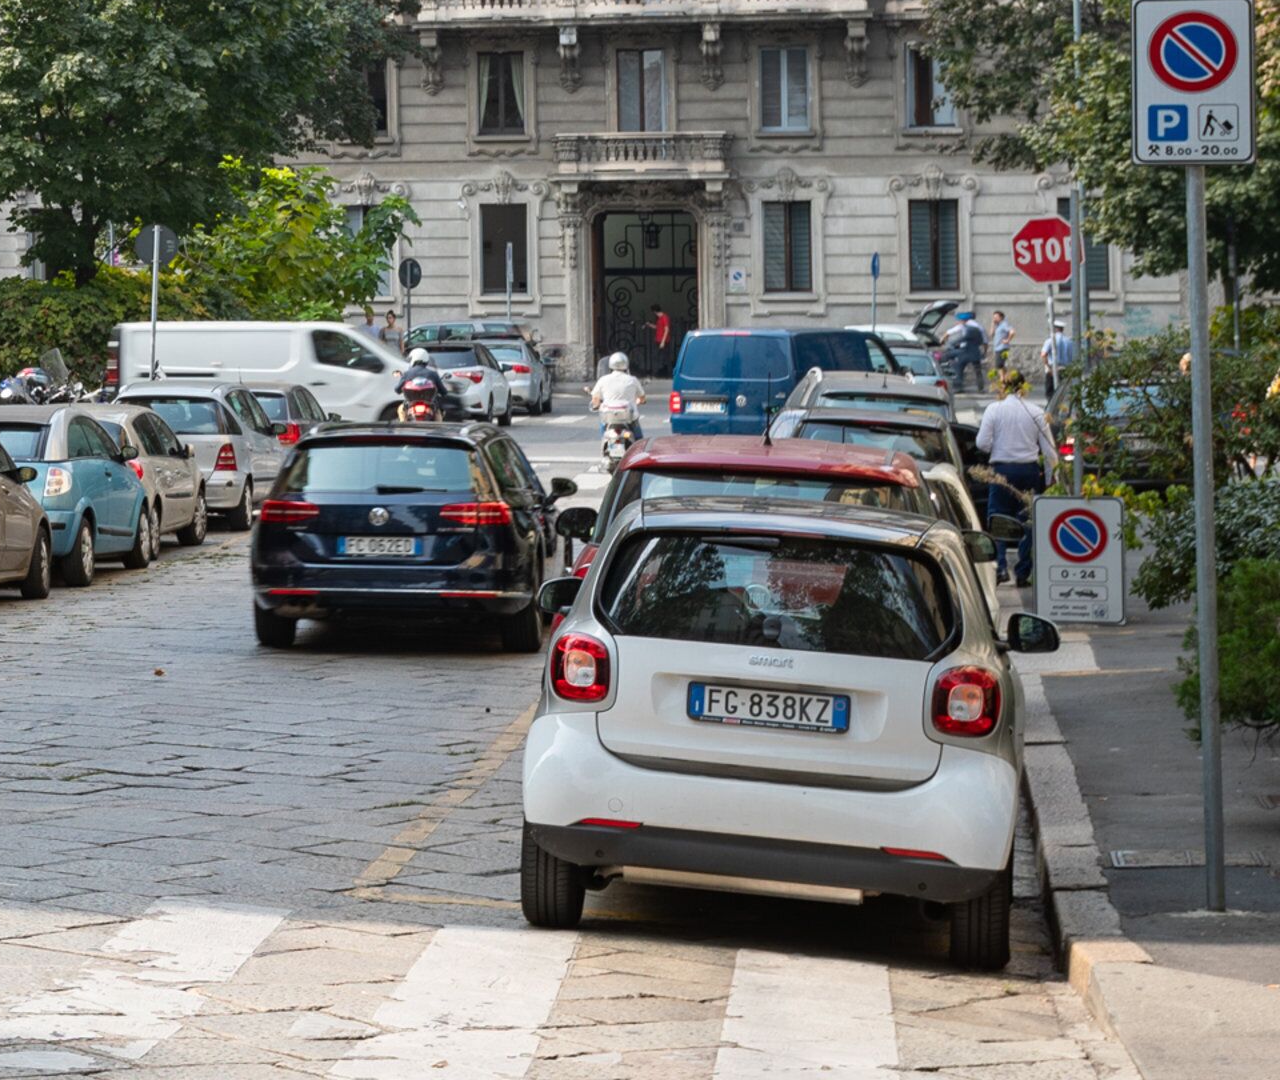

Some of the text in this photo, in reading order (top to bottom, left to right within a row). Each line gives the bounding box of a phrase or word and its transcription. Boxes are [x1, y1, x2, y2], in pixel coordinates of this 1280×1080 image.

[1157, 109, 1181, 138] P
[1080, 569, 1096, 579] 24
[749, 654, 794, 669] smart
[707, 689, 738, 715] FG
[748, 692, 831, 724] 838KZ
